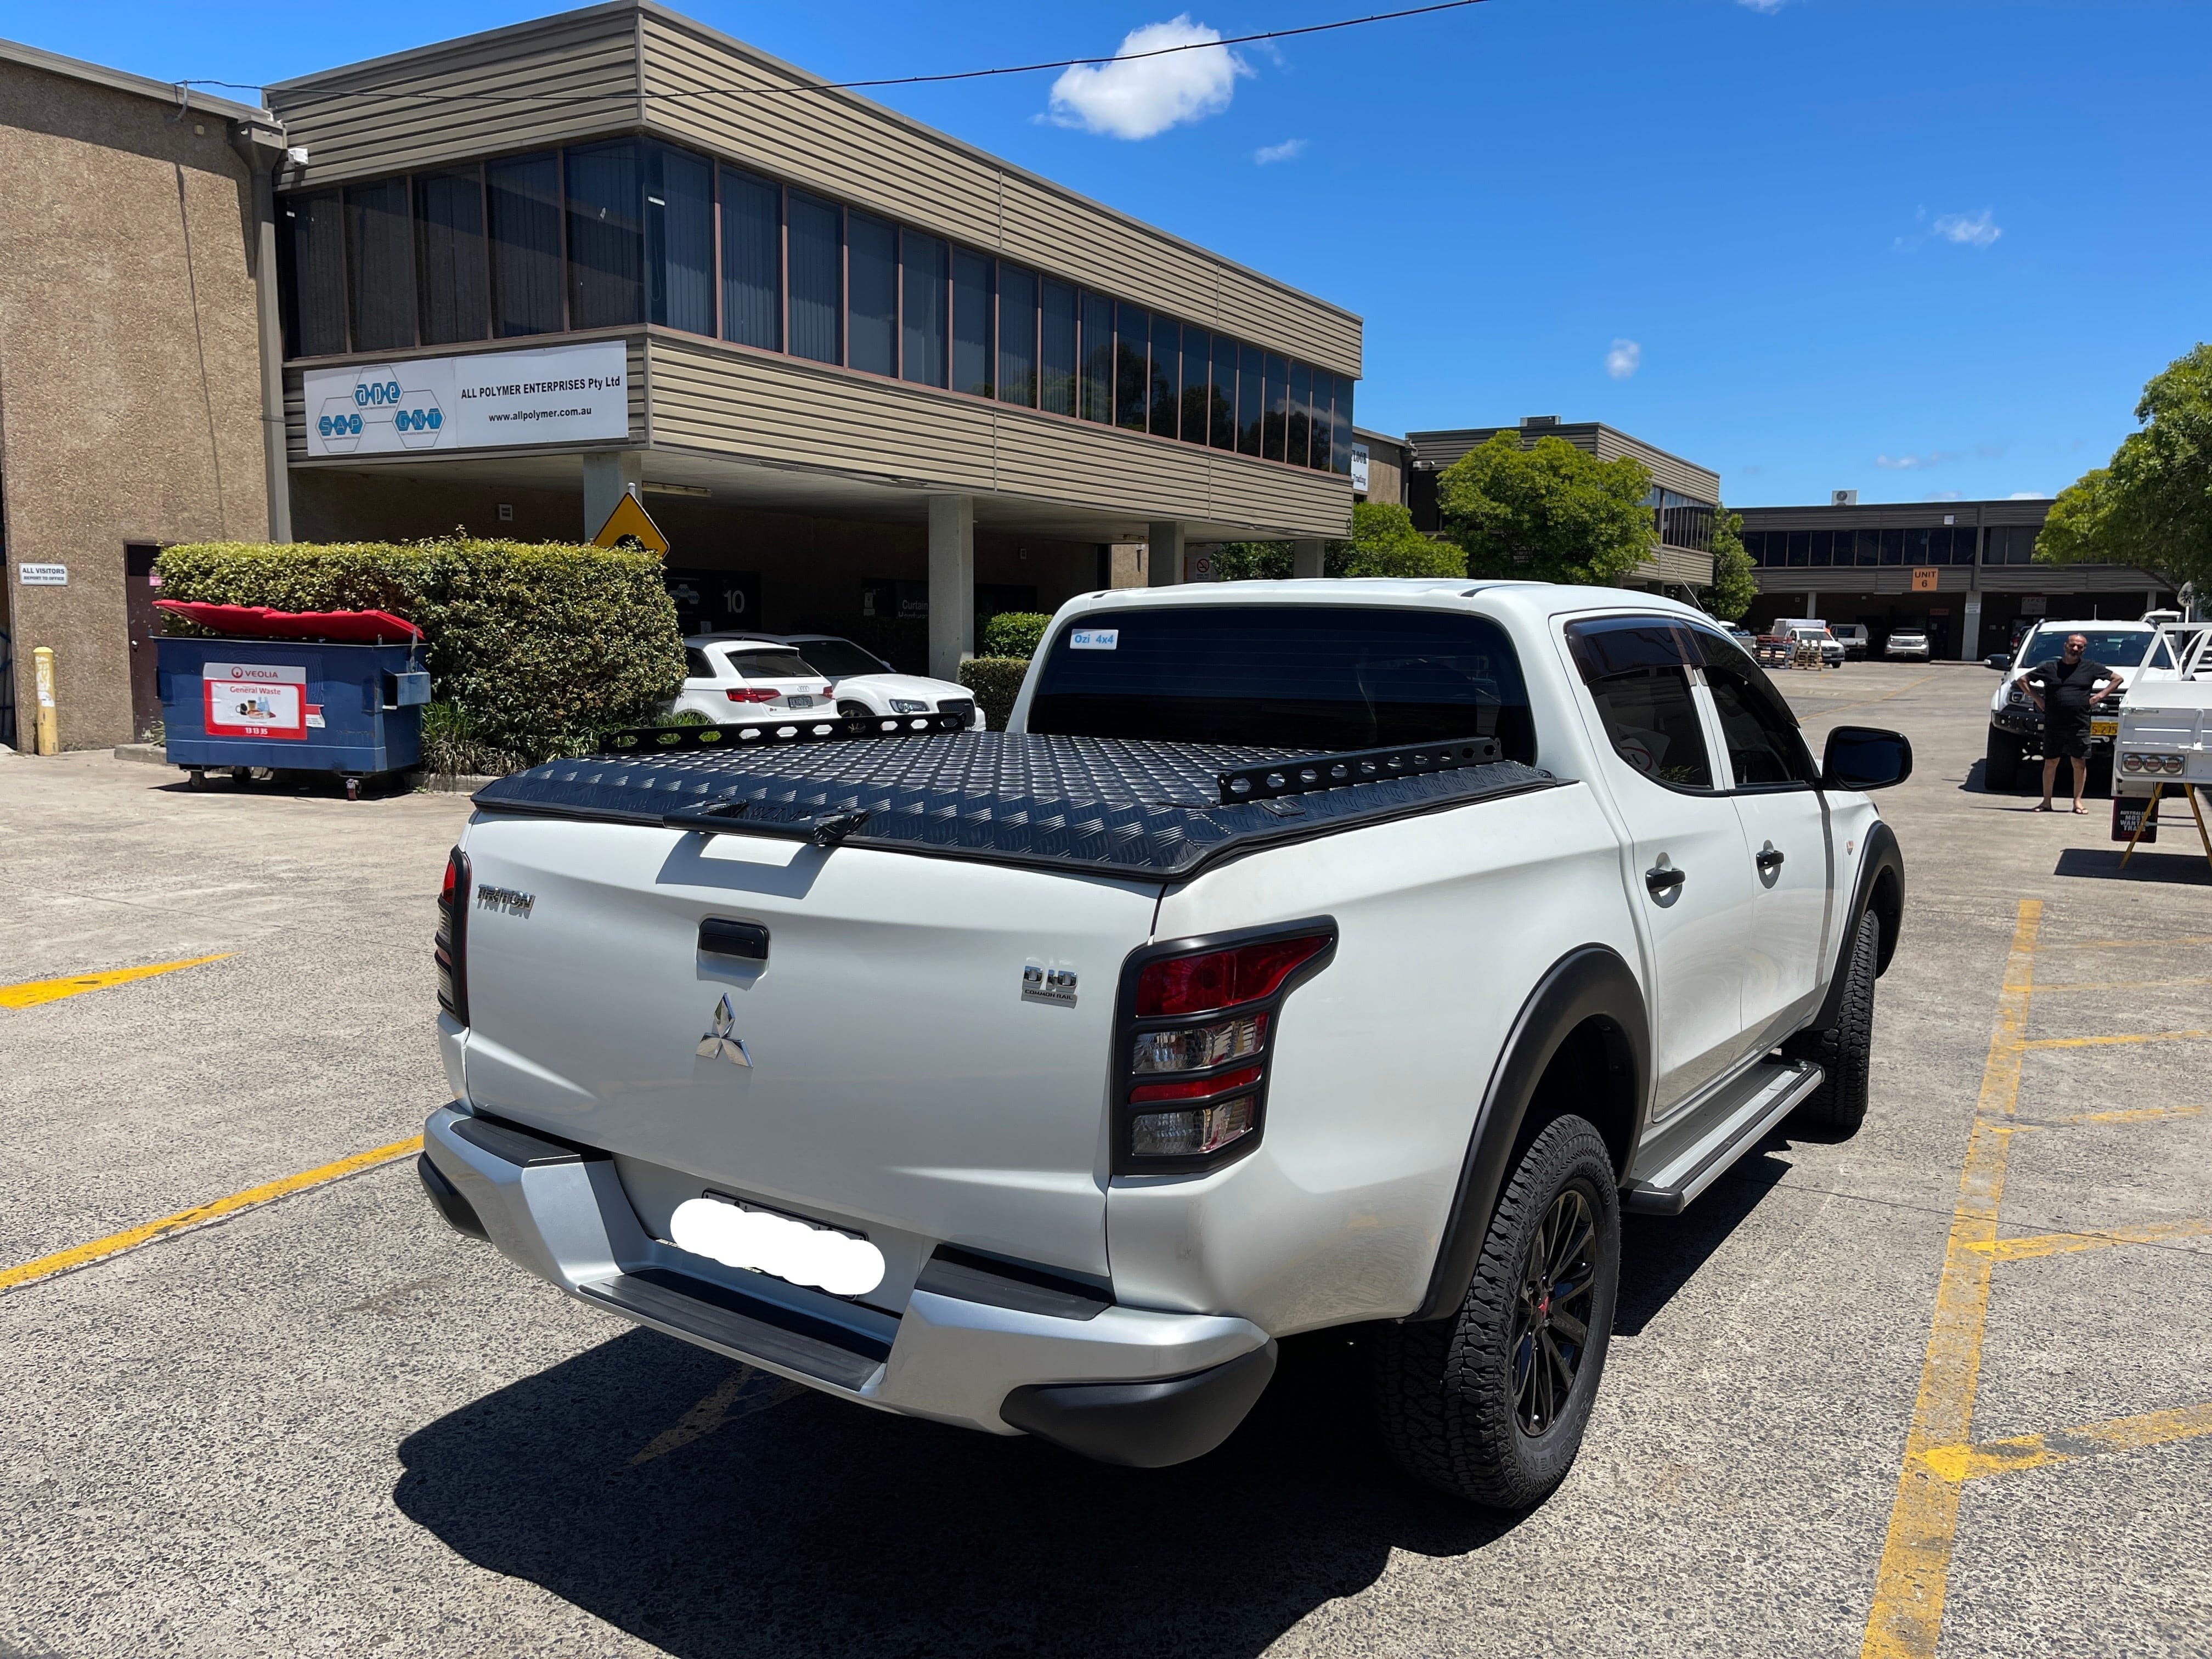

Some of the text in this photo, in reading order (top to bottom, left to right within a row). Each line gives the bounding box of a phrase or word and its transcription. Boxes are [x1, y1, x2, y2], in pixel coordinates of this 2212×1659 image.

[461, 376, 620, 399] ALL POLYMER ENTERPRISES Pty Ltd
[397, 410, 441, 429] GNT
[489, 407, 591, 421] www.allpolymer.com.au
[320, 416, 360, 433] SAP
[724, 590, 744, 613] 10
[1074, 634, 1114, 644] Ozi 4x4
[477, 884, 536, 910] TRITON
[1025, 989, 1054, 997] COMMON
